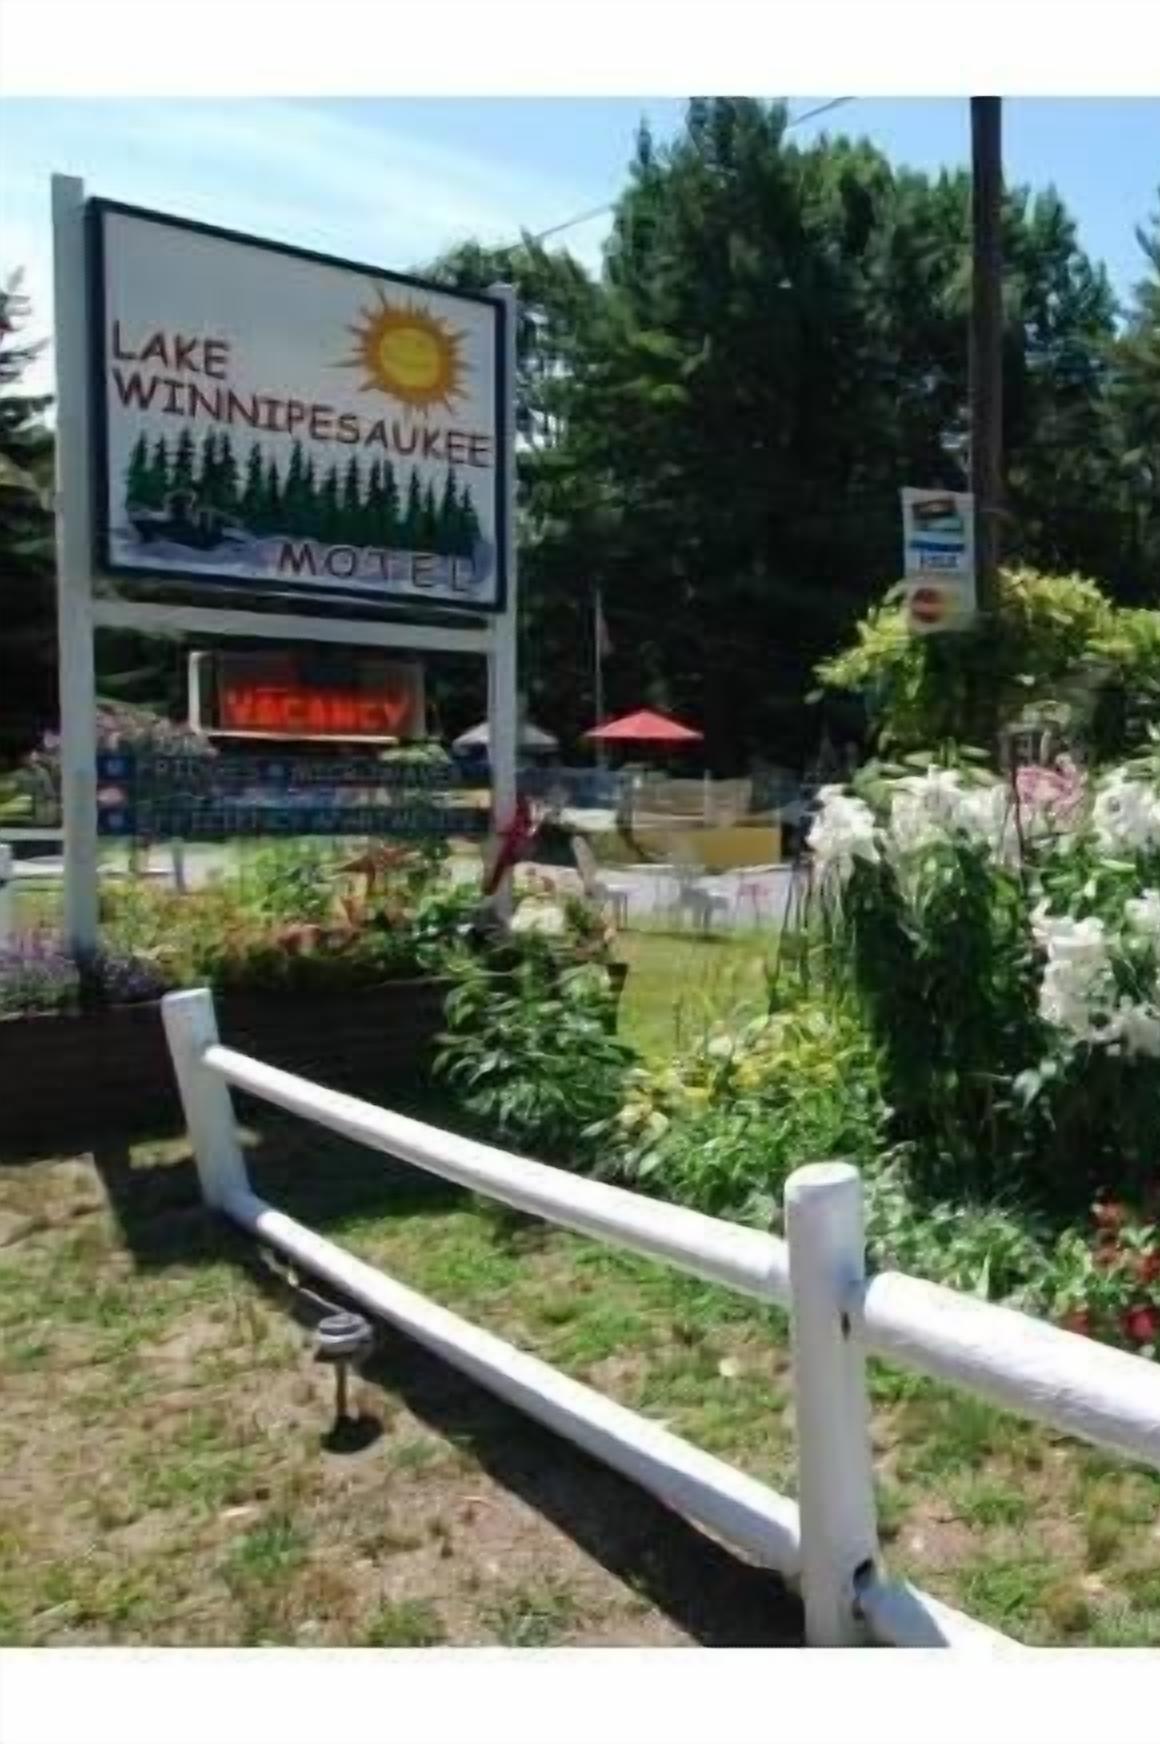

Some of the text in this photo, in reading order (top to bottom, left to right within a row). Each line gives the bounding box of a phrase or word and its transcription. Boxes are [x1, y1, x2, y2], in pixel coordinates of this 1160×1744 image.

[112, 319, 230, 379] LAKE
[113, 369, 493, 468] WINNIPESAUKEE
[277, 543, 476, 593] MOTEL
